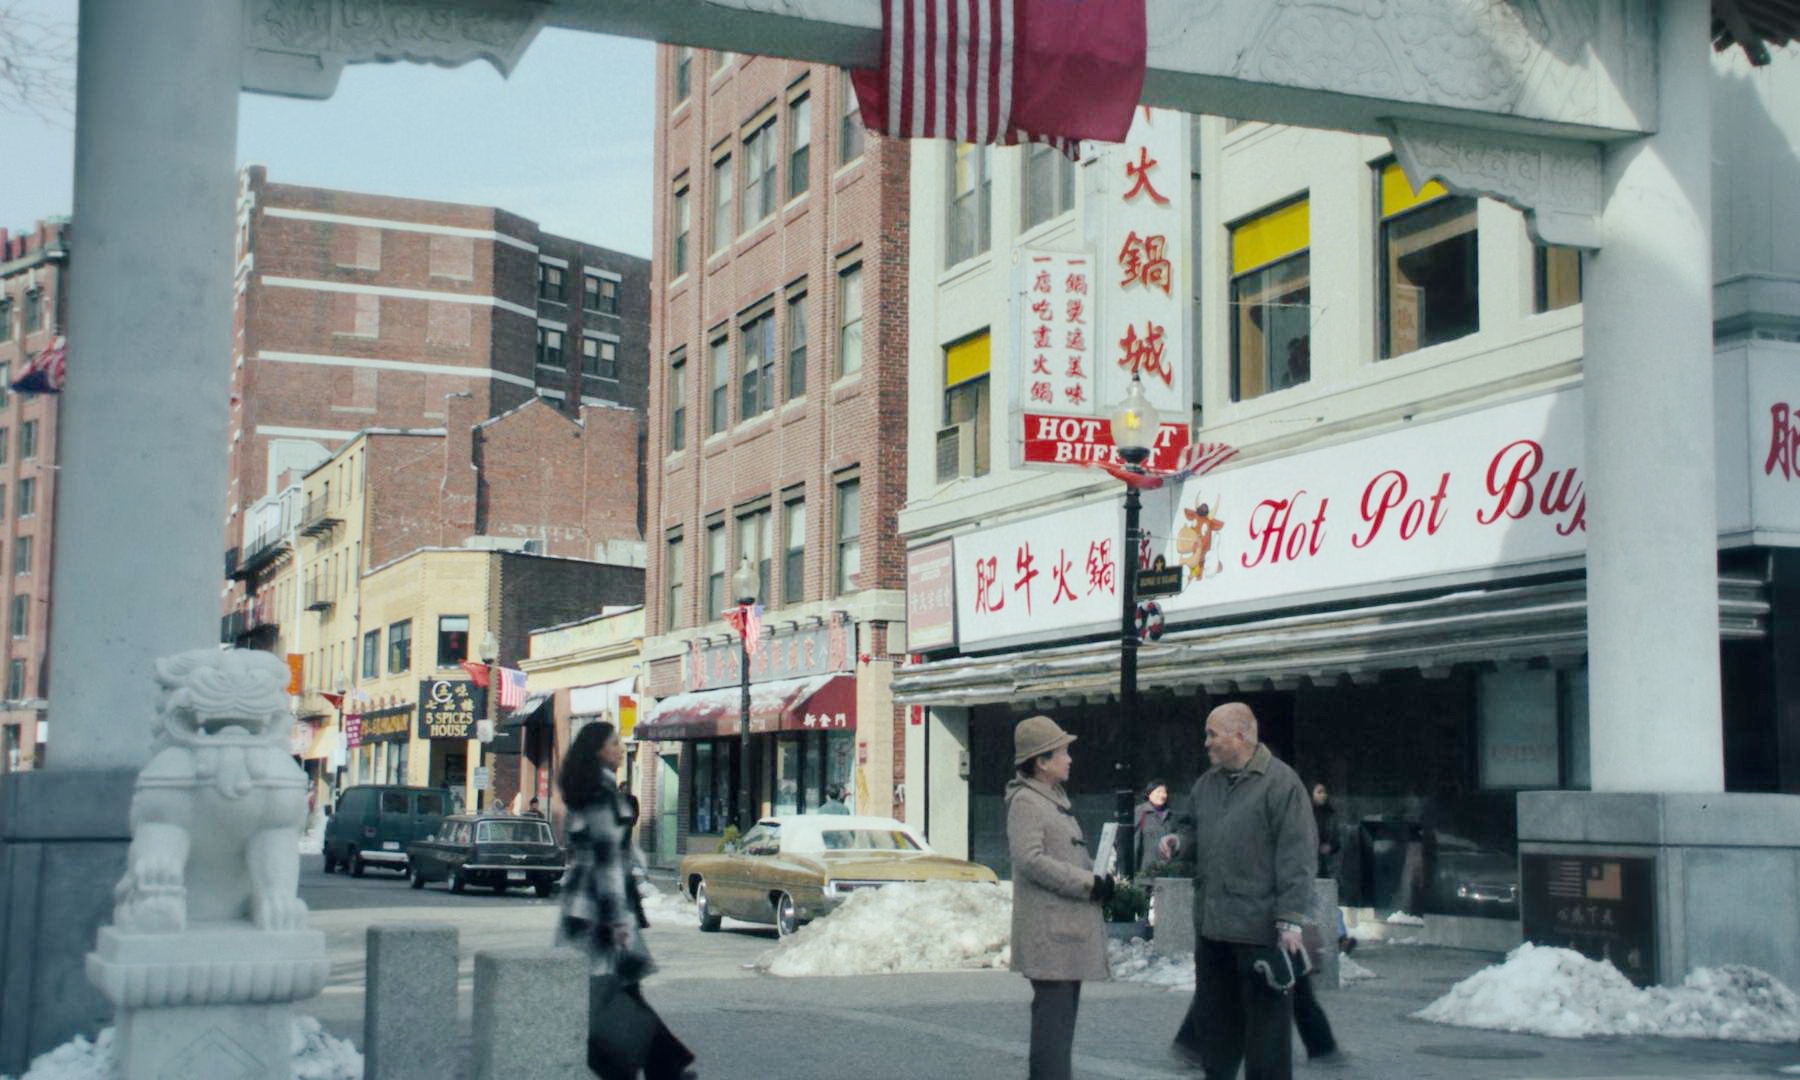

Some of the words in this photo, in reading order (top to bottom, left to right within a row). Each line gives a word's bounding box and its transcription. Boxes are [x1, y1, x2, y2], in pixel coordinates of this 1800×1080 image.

[1117, 104, 1172, 386] 火鍋城
[1037, 417, 1100, 443] HOT
[1055, 441, 1161, 467] BUFFT
[1241, 490, 1329, 568] Hot
[1352, 470, 1451, 548] Pot
[430, 724, 468, 737] HOUSE
[435, 711, 474, 725] SPICES
[803, 712, 847, 728] 新金門
